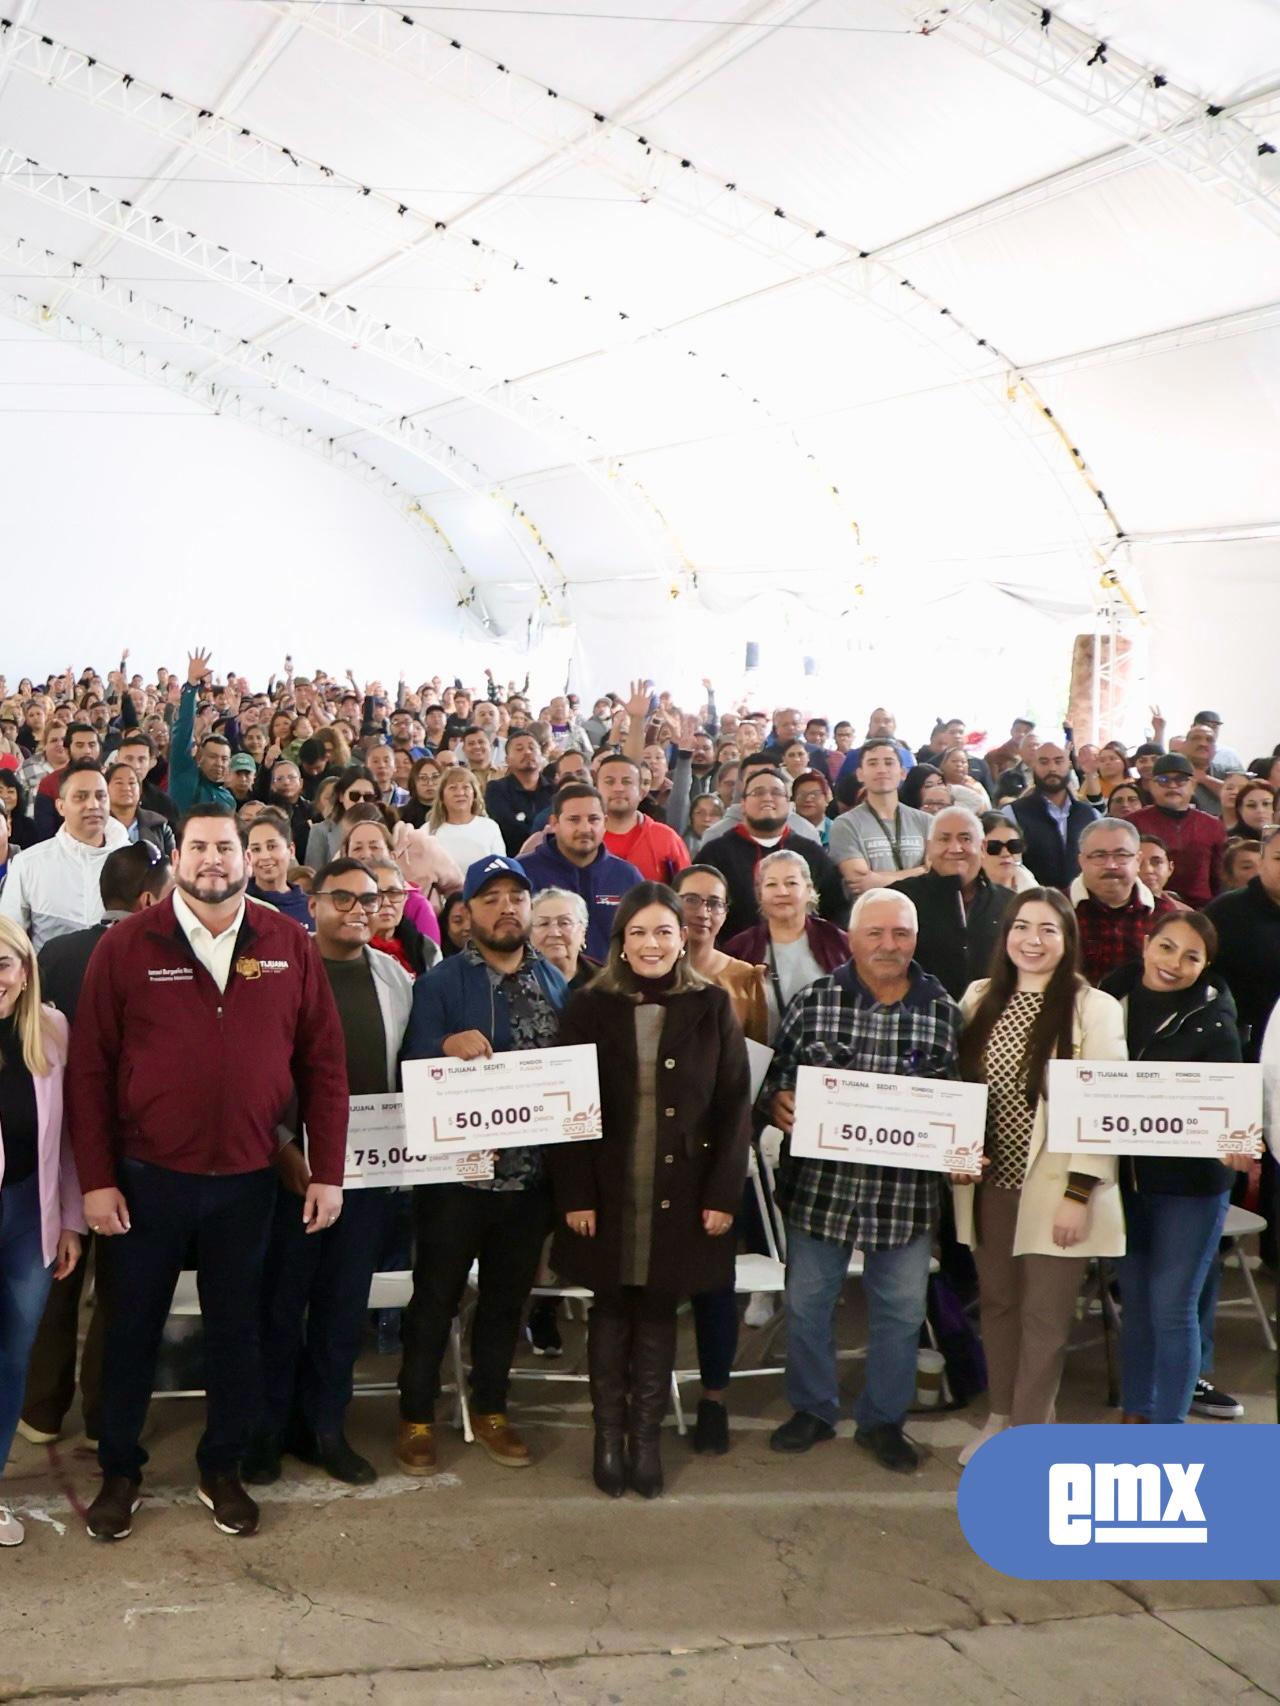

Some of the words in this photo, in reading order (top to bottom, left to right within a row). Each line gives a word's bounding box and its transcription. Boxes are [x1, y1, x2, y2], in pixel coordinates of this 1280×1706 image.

[868, 839, 921, 848] AEROTALE
[260, 960, 288, 968] TIJUANA
[447, 1065, 477, 1074] TIJUANA
[483, 1063, 506, 1071] SEDETI
[841, 1080, 870, 1089] TIJUANA
[876, 1083, 898, 1091] SEDETI
[456, 1106, 531, 1129] 50,000
[533, 1105, 544, 1113] 00
[1102, 1116, 1183, 1136] 50,000
[841, 1124, 915, 1146] 50,000
[918, 1131, 929, 1139] 00
